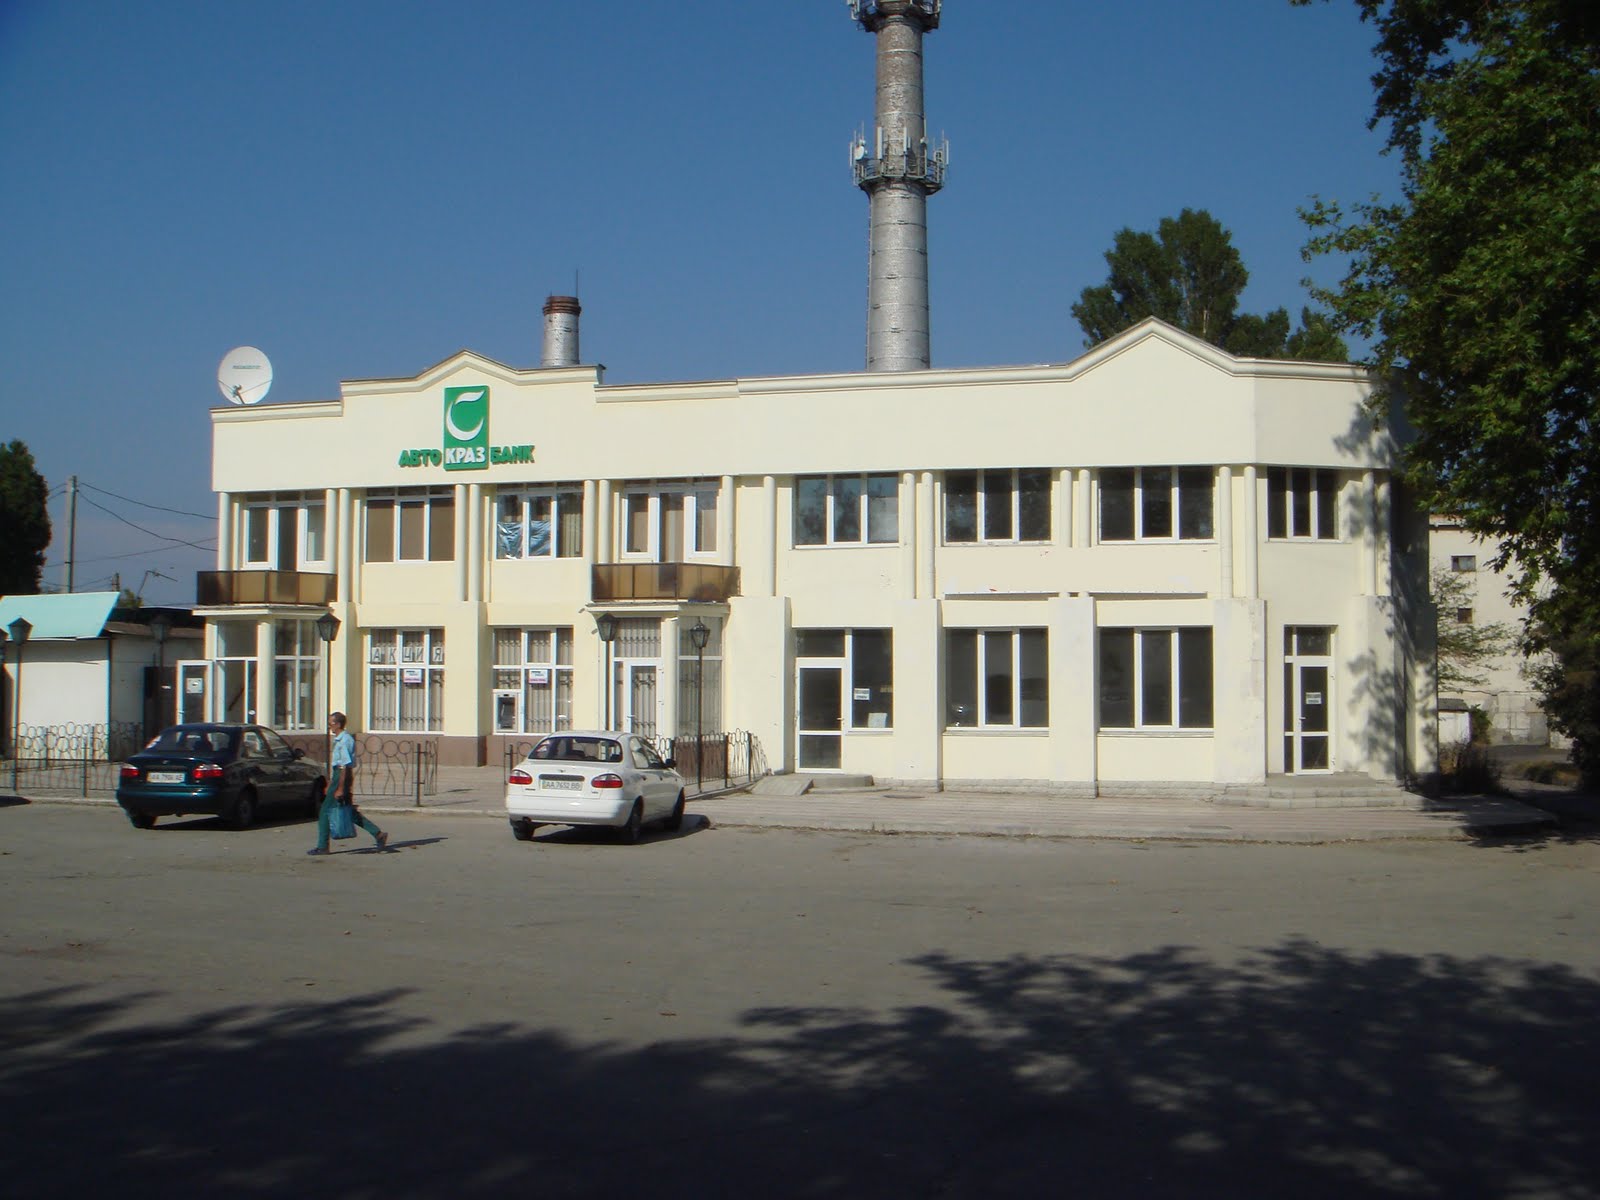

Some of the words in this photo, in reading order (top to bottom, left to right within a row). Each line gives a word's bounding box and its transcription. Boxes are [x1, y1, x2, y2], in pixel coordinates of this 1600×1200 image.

[399, 449, 442, 467] АВТО
[445, 447, 486, 464] КРАЗ
[490, 445, 535, 464] БАНК
[373, 647, 443, 661] АКЦИЯ
